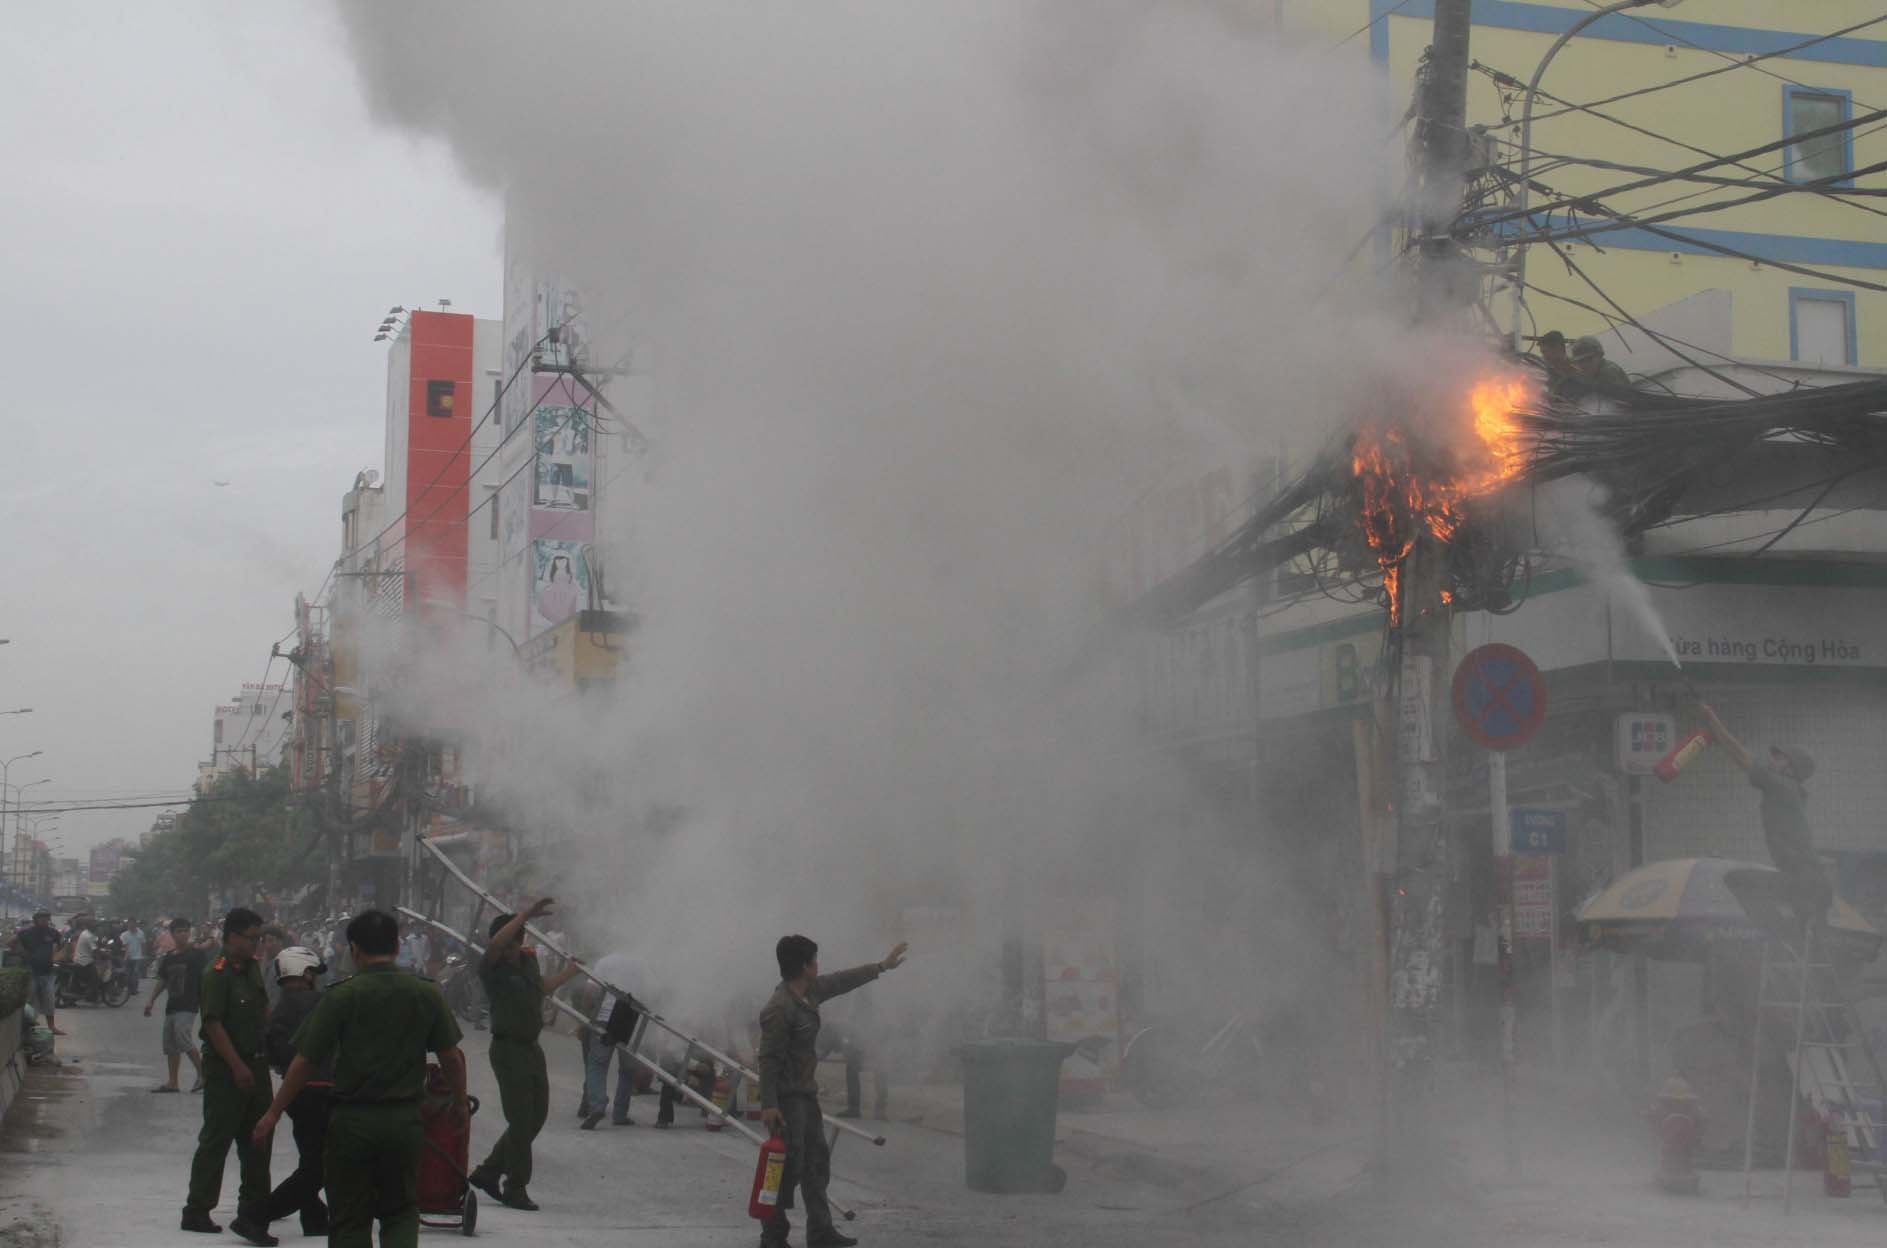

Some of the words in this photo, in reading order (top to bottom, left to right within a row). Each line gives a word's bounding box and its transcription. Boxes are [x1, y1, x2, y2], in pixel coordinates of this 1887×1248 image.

[1708, 634, 1758, 662] hàng
[1763, 638, 1817, 663] Cộng
[1822, 639, 1861, 660] Hòa
